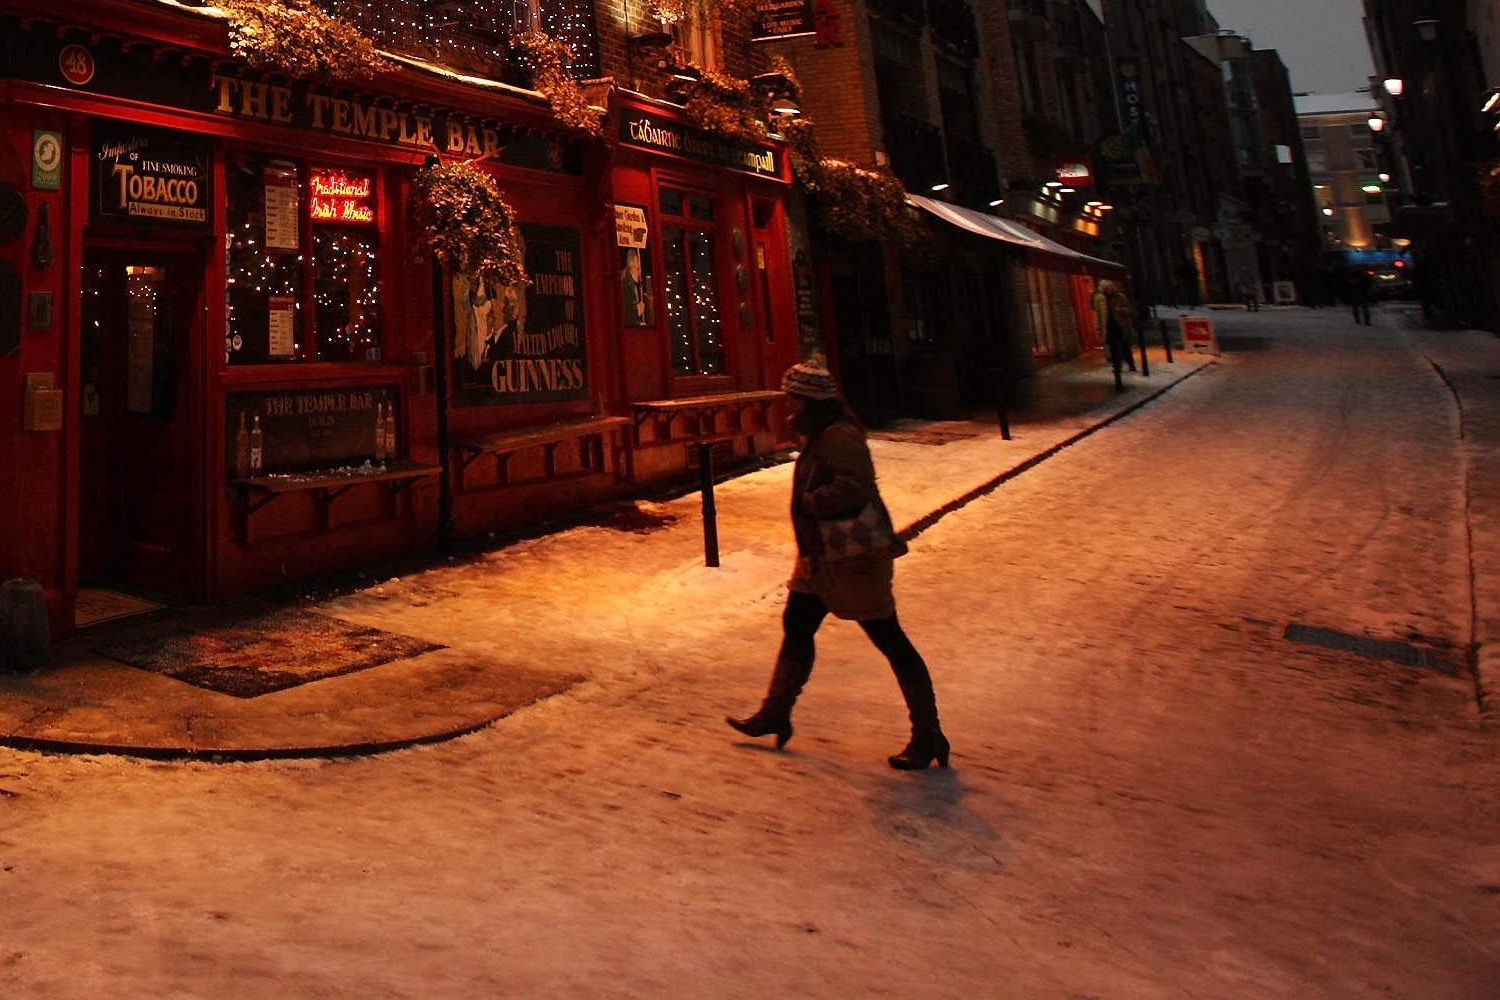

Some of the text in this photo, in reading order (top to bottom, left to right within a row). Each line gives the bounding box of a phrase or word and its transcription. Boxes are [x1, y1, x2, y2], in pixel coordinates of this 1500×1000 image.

[64, 48, 88, 76] 48
[212, 75, 293, 123] THE
[304, 93, 437, 148] TEMPLE
[446, 118, 499, 158] BAR
[129, 152, 141, 161] OF
[142, 160, 197, 177] FINE SMOKING
[111, 163, 198, 209] TOBACCO
[311, 176, 370, 196] Traditional
[130, 203, 162, 216] Always
[179, 207, 205, 220] Stock
[310, 197, 373, 221] Irish Music
[491, 359, 585, 393] GUINNESS
[266, 391, 373, 416] THE TEMPLE BAR
